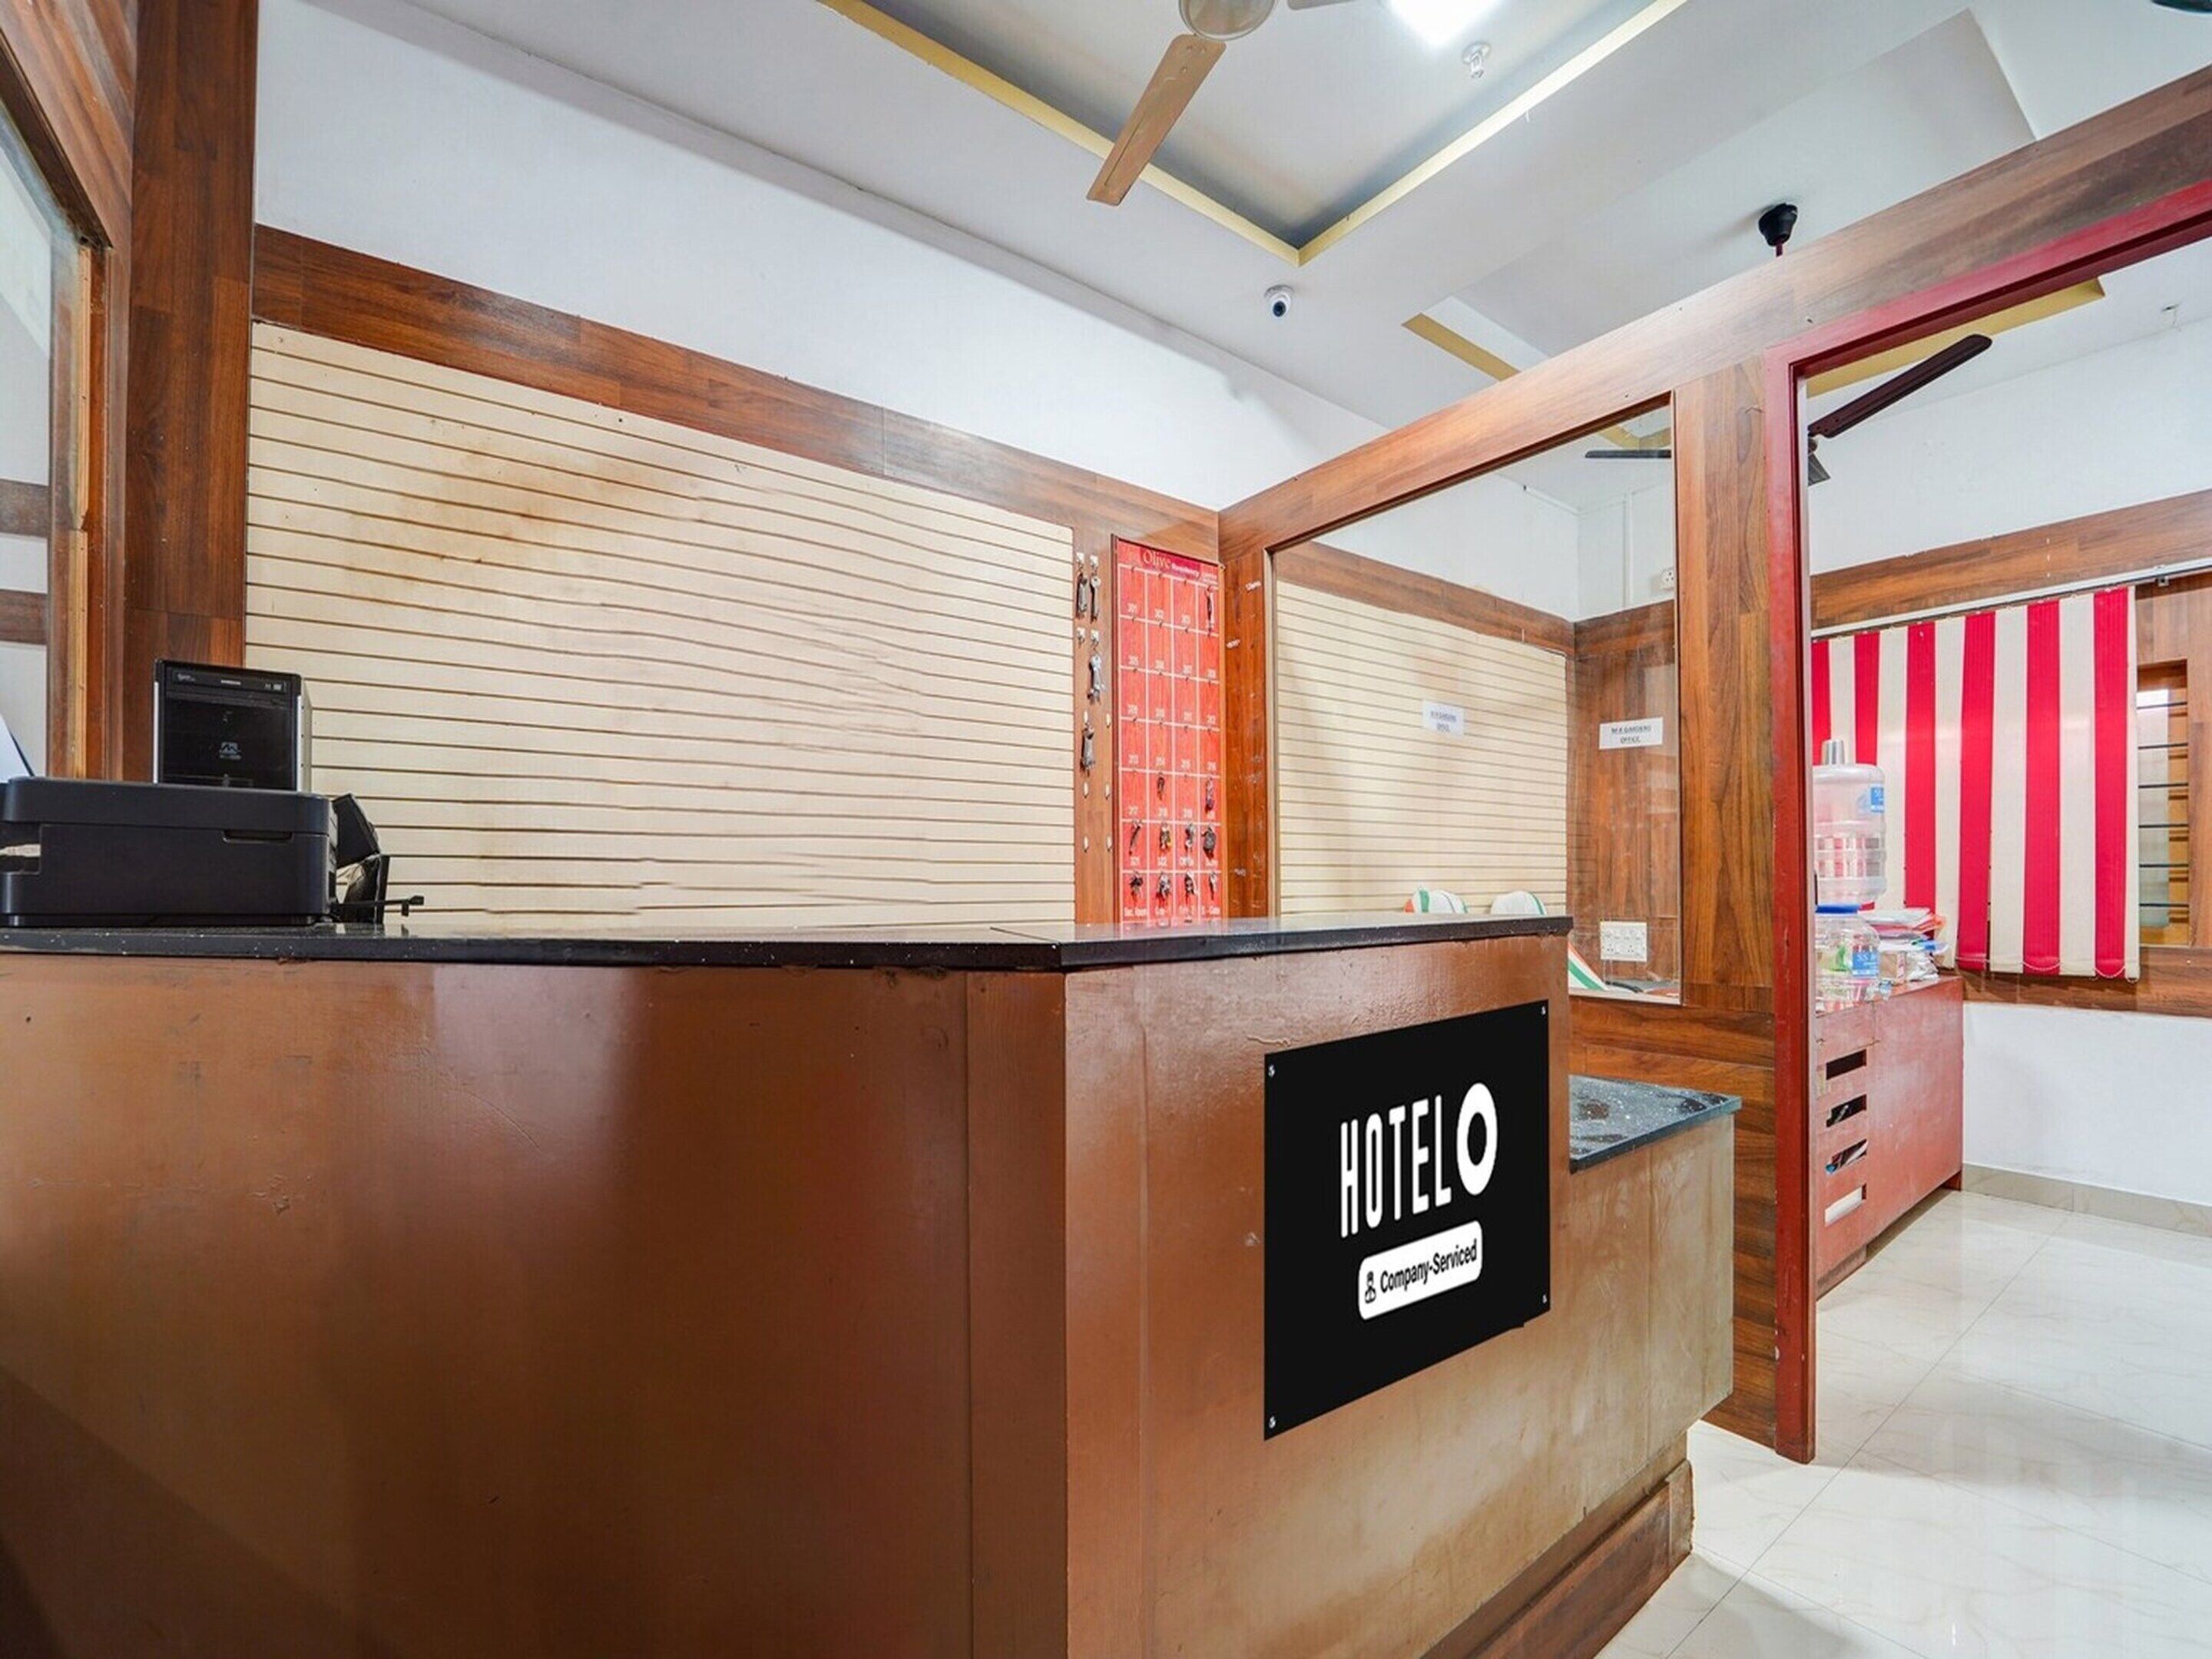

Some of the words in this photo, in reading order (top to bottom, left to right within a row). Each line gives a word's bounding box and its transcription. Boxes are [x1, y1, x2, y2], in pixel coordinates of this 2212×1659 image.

[1143, 550, 1171, 568] Olive
[1340, 1094, 1452, 1238] HOTEL
[1456, 1081, 1498, 1196] O
[1379, 1238, 1478, 1293] Company-Serviced
